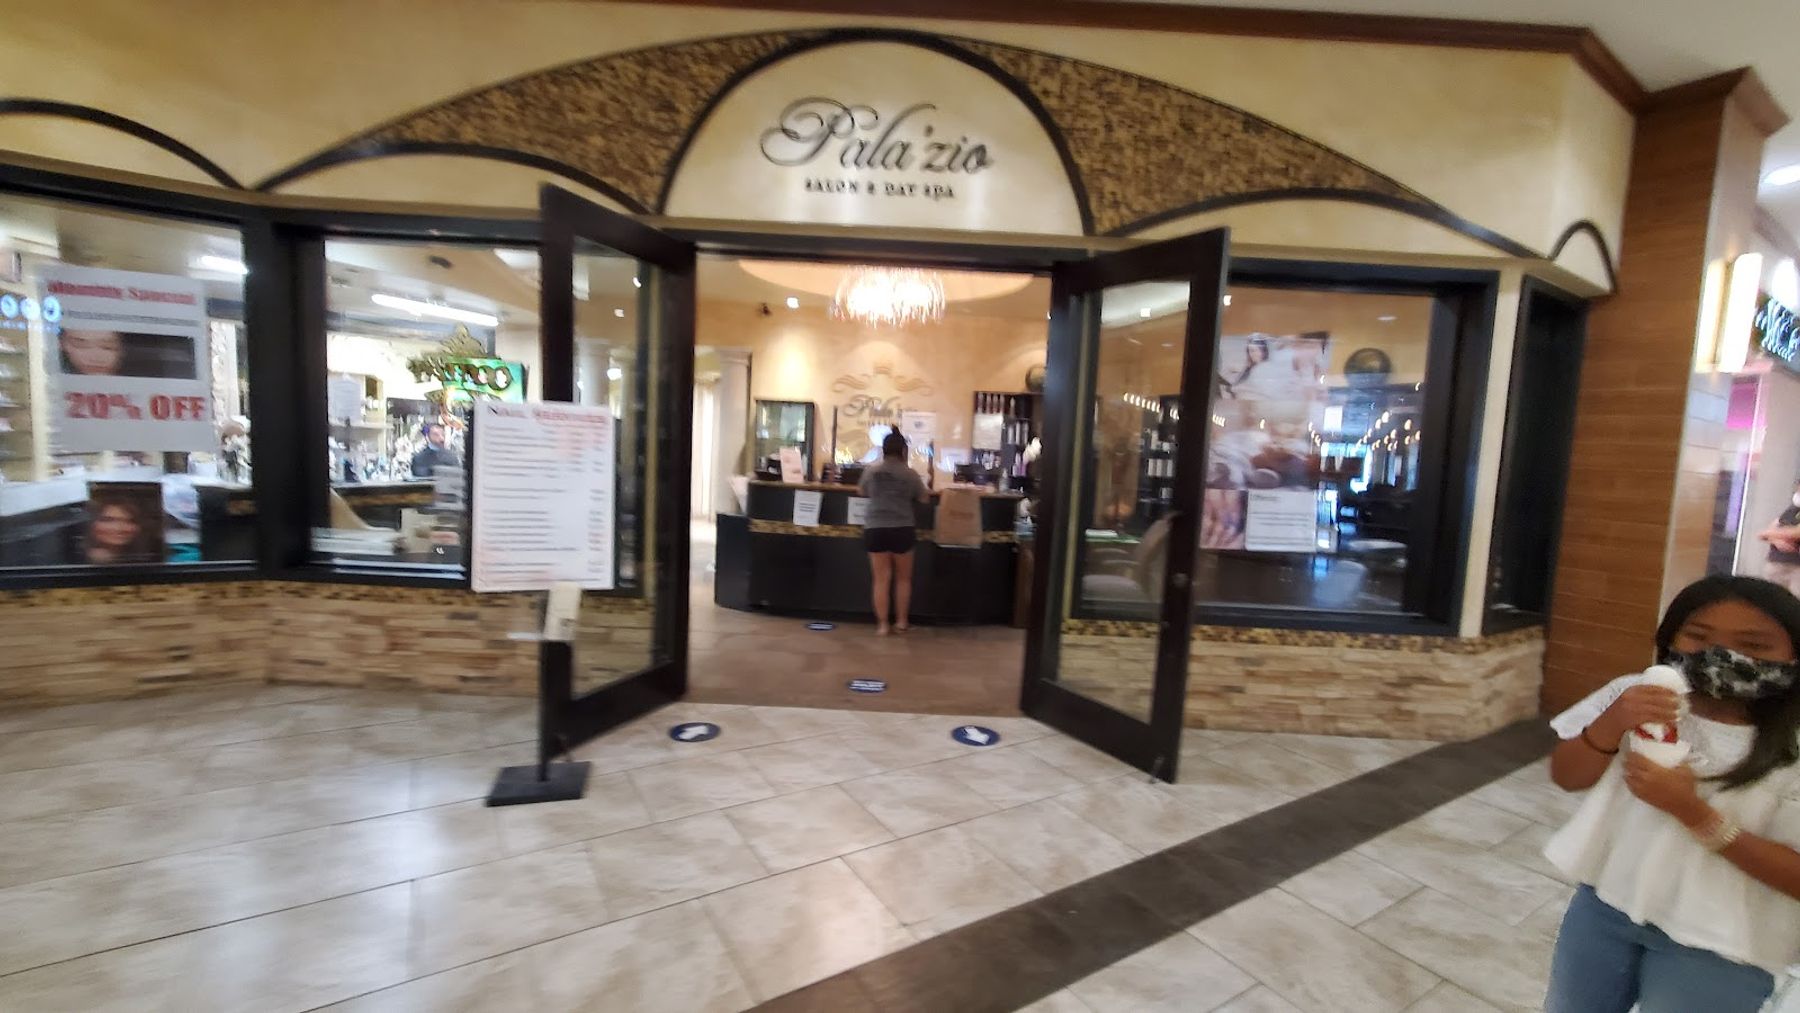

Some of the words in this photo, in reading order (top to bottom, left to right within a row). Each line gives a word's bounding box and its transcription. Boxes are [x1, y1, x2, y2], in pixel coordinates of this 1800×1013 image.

[760, 96, 992, 174] Pala'zio
[804, 177, 859, 194] SALON
[65, 391, 142, 420] 20%
[150, 394, 206, 421] OFF
